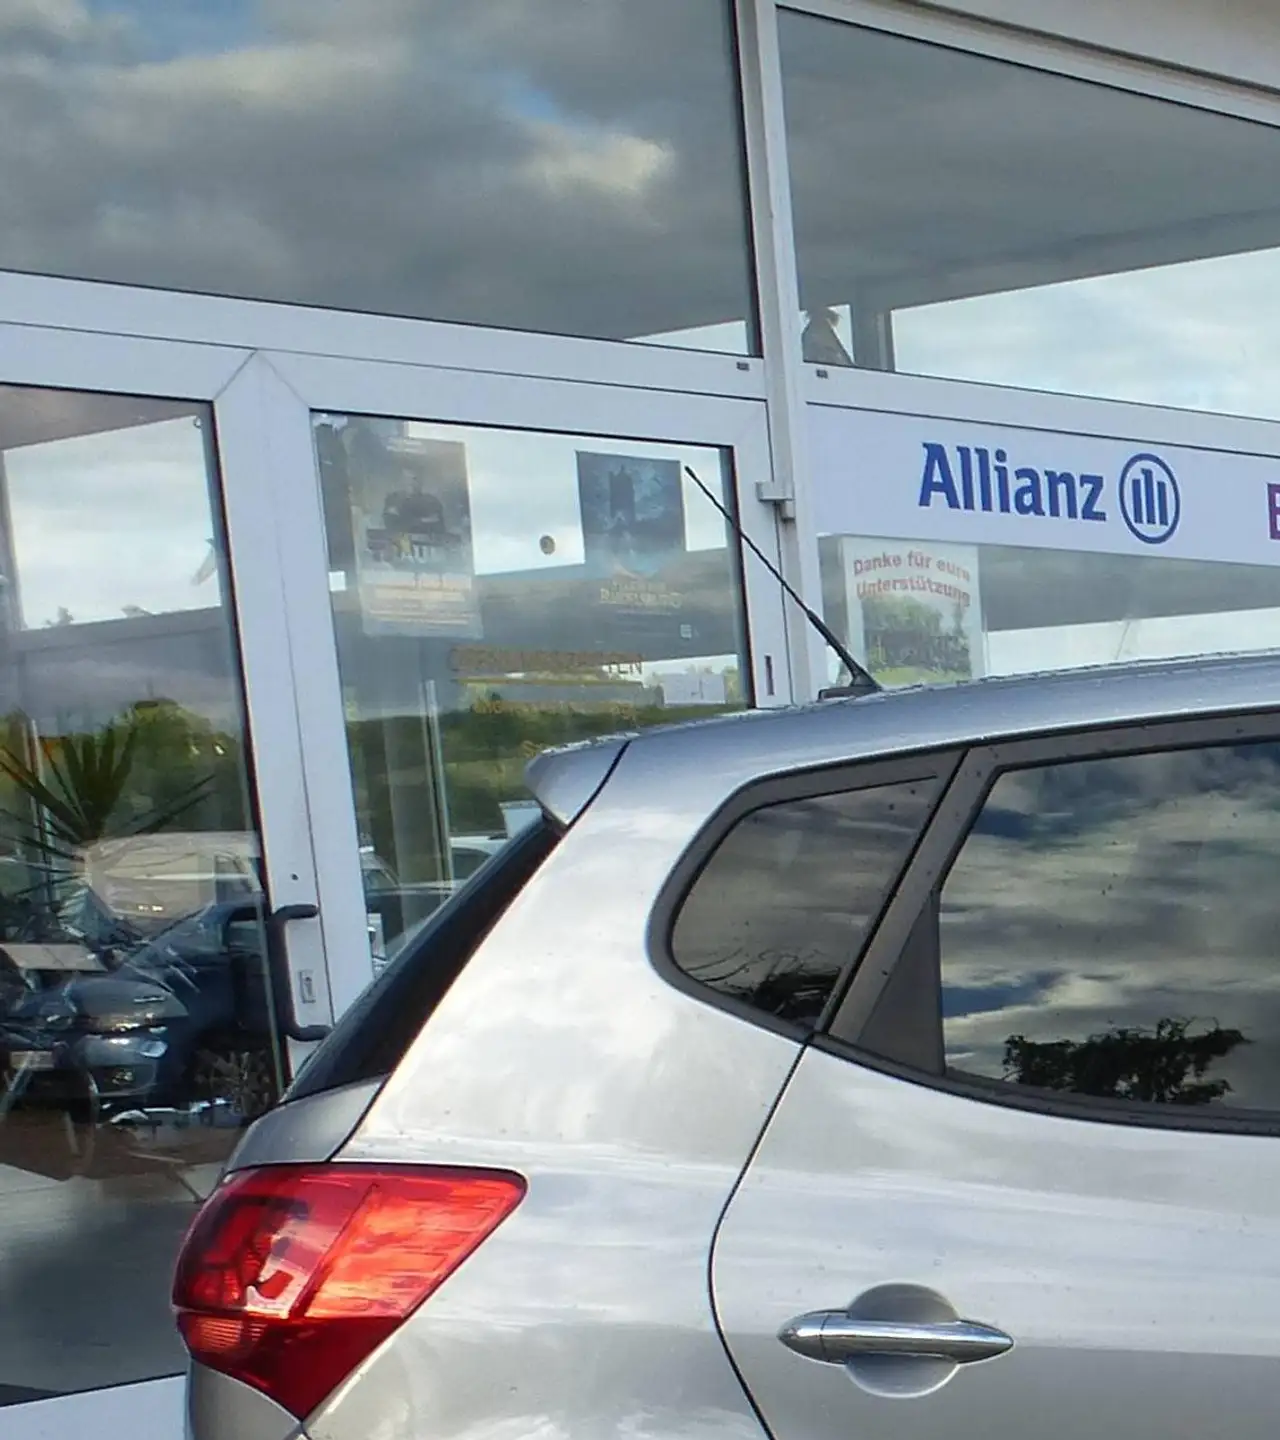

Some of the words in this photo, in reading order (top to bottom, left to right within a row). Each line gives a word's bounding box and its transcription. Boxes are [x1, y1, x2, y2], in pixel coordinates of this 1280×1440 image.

[918, 442, 1106, 521] Allianz
[853, 552, 902, 577] Danke
[907, 550, 932, 568] für
[856, 575, 971, 607] Unterstützung
